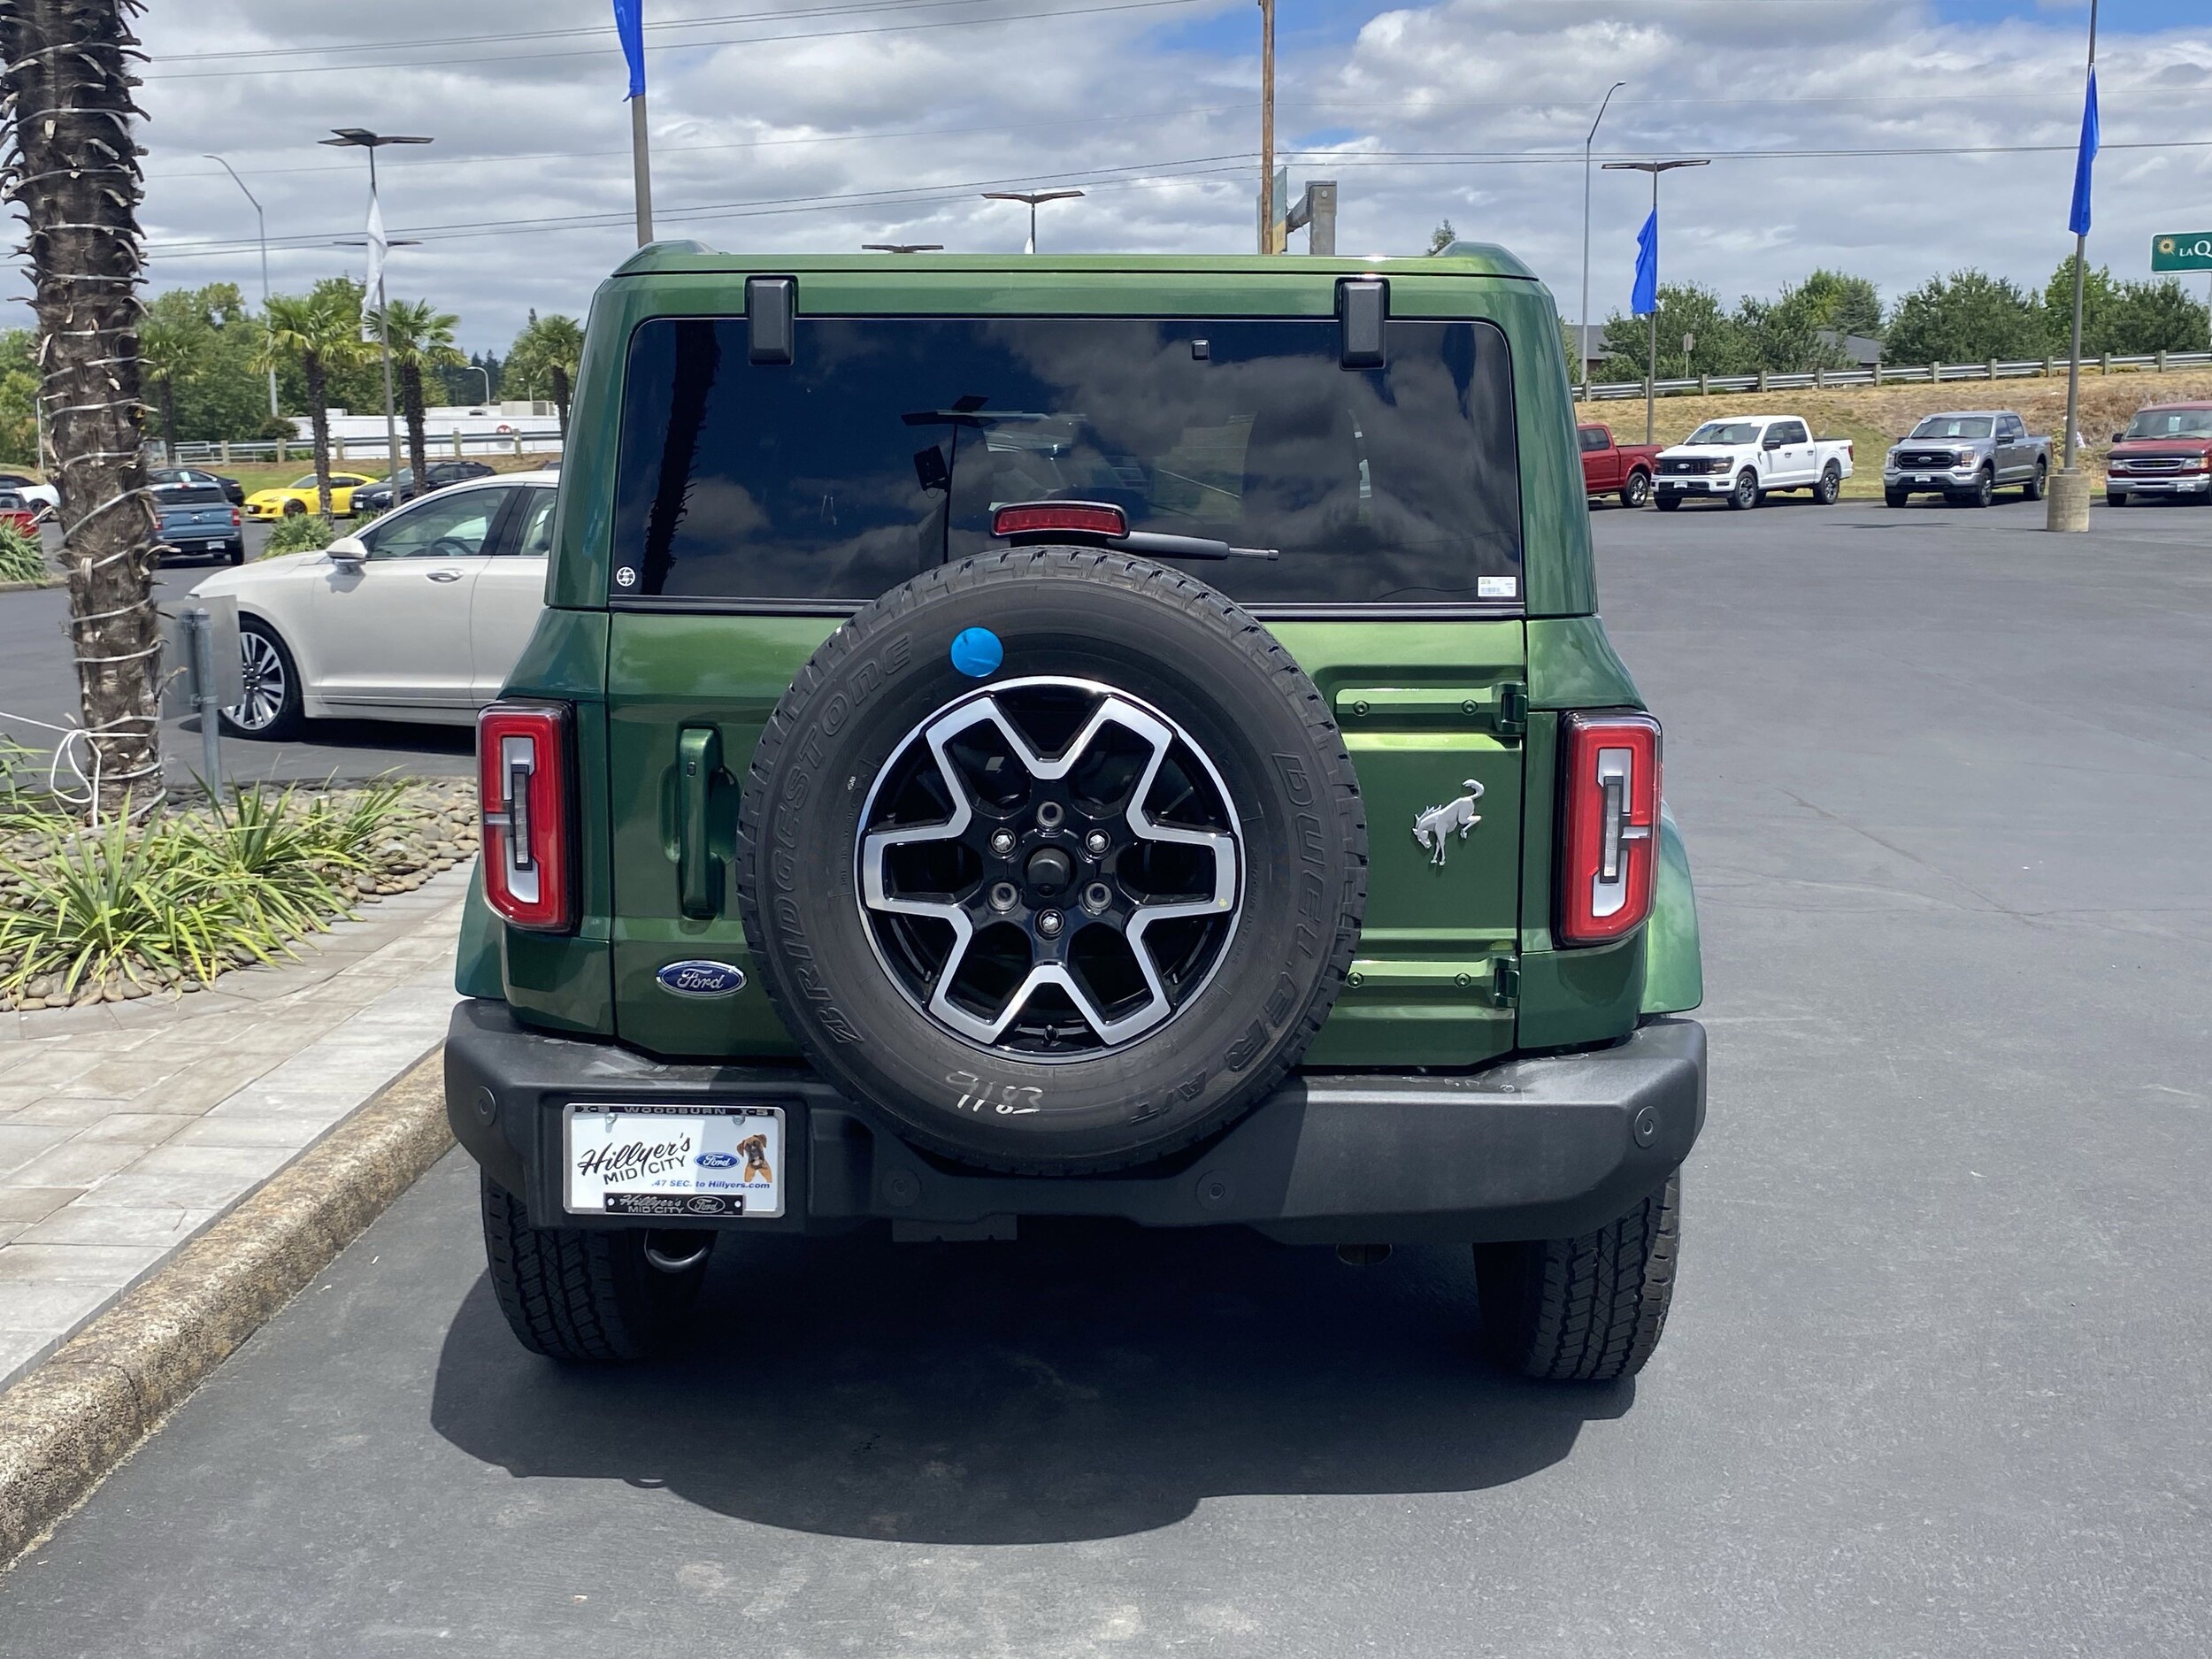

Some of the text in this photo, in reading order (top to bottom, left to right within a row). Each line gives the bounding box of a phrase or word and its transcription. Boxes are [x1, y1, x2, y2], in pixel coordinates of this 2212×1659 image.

[2179, 248, 2193, 257] LA
[677, 968, 725, 989] Ford
[624, 1106, 726, 1115] WOODBURN
[577, 1133, 691, 1177] Hillyer's
[703, 1154, 731, 1167] Ford
[603, 1155, 686, 1185] MID CITY
[709, 1180, 770, 1189] Hillyers.com
[619, 1194, 682, 1210] Hillyer's
[695, 1199, 718, 1211] Ford
